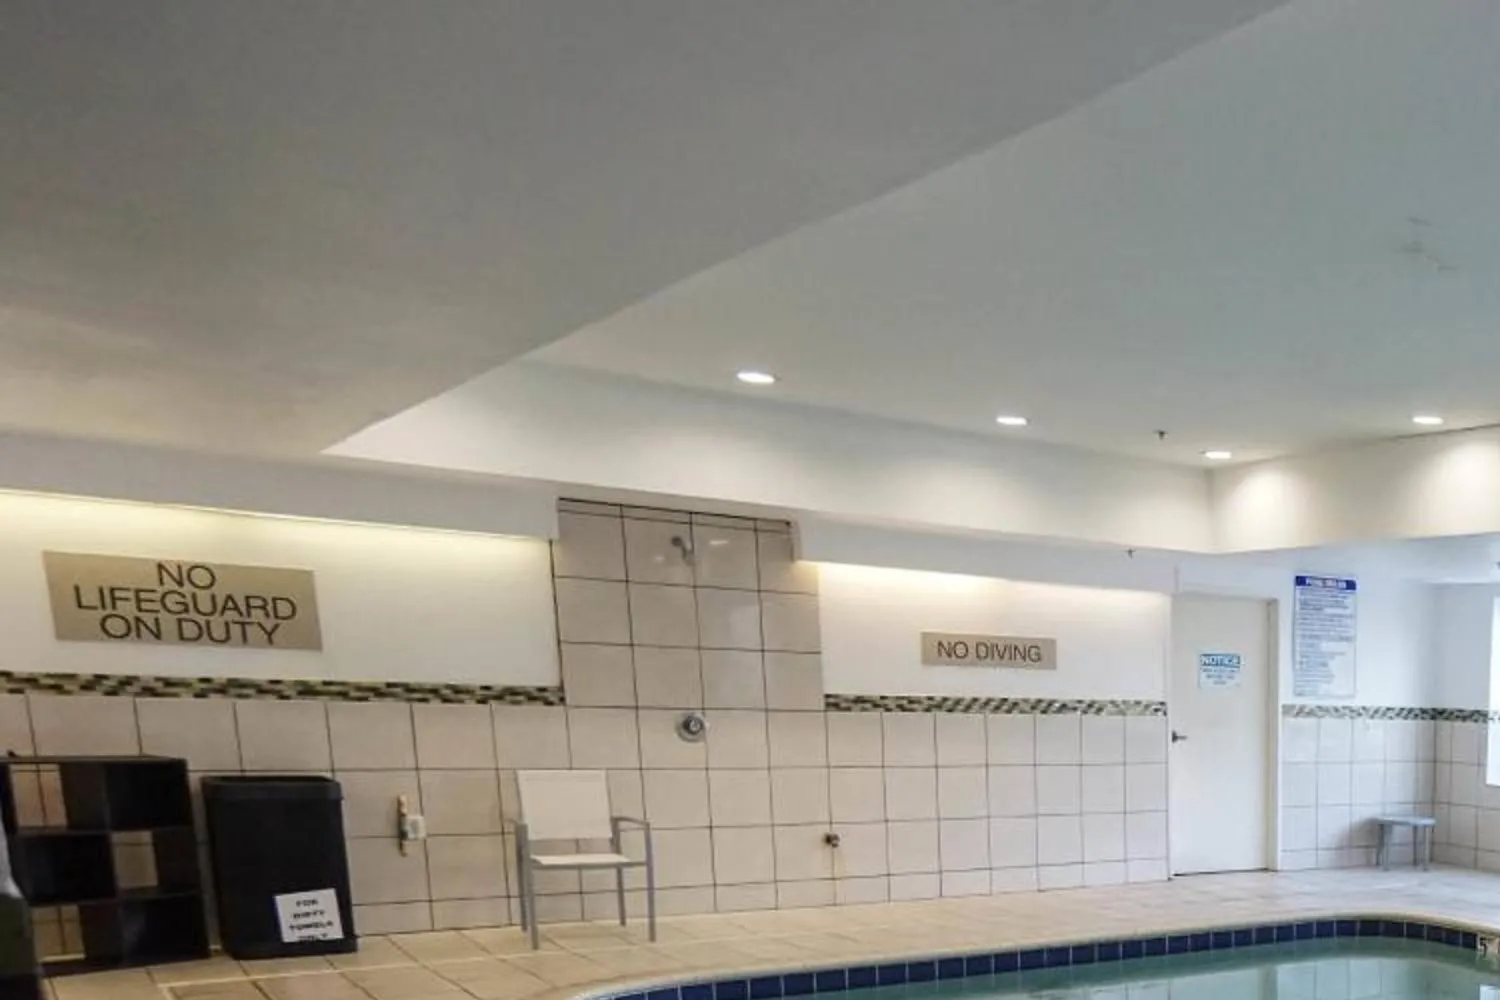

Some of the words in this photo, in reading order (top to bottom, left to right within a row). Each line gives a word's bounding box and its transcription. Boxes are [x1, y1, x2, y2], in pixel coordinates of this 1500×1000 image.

[156, 562, 216, 590] NO
[74, 584, 297, 620] LIFEGUARD
[100, 613, 162, 641] ON
[176, 617, 281, 645] DUTY
[937, 641, 969, 659] NO
[975, 641, 1042, 662] DIVING
[1201, 655, 1240, 667] NOTICE
